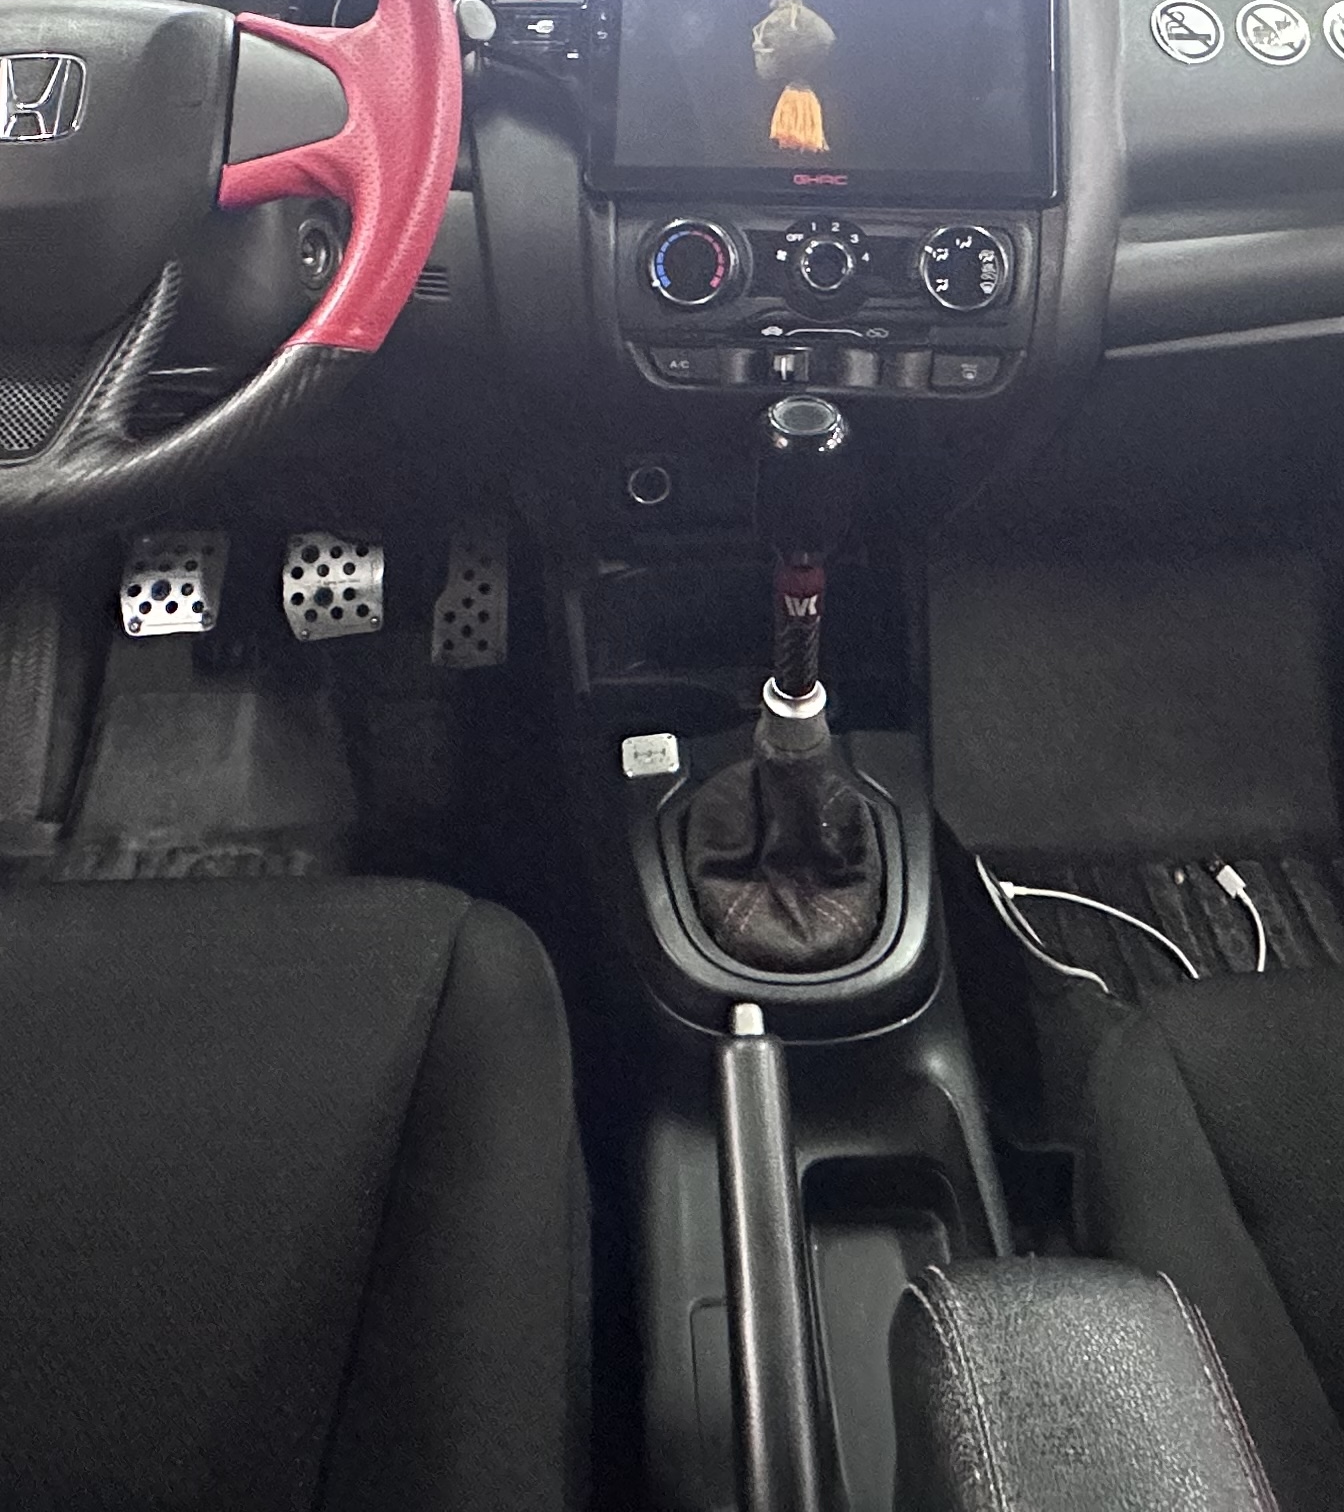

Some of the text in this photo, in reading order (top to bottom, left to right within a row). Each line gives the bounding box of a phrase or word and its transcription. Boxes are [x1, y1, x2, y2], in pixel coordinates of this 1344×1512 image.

[811, 221, 817, 232] 1
[831, 221, 840, 233] 2
[785, 233, 805, 243] OFF
[849, 233, 860, 244] 3
[861, 251, 870, 263] 4
